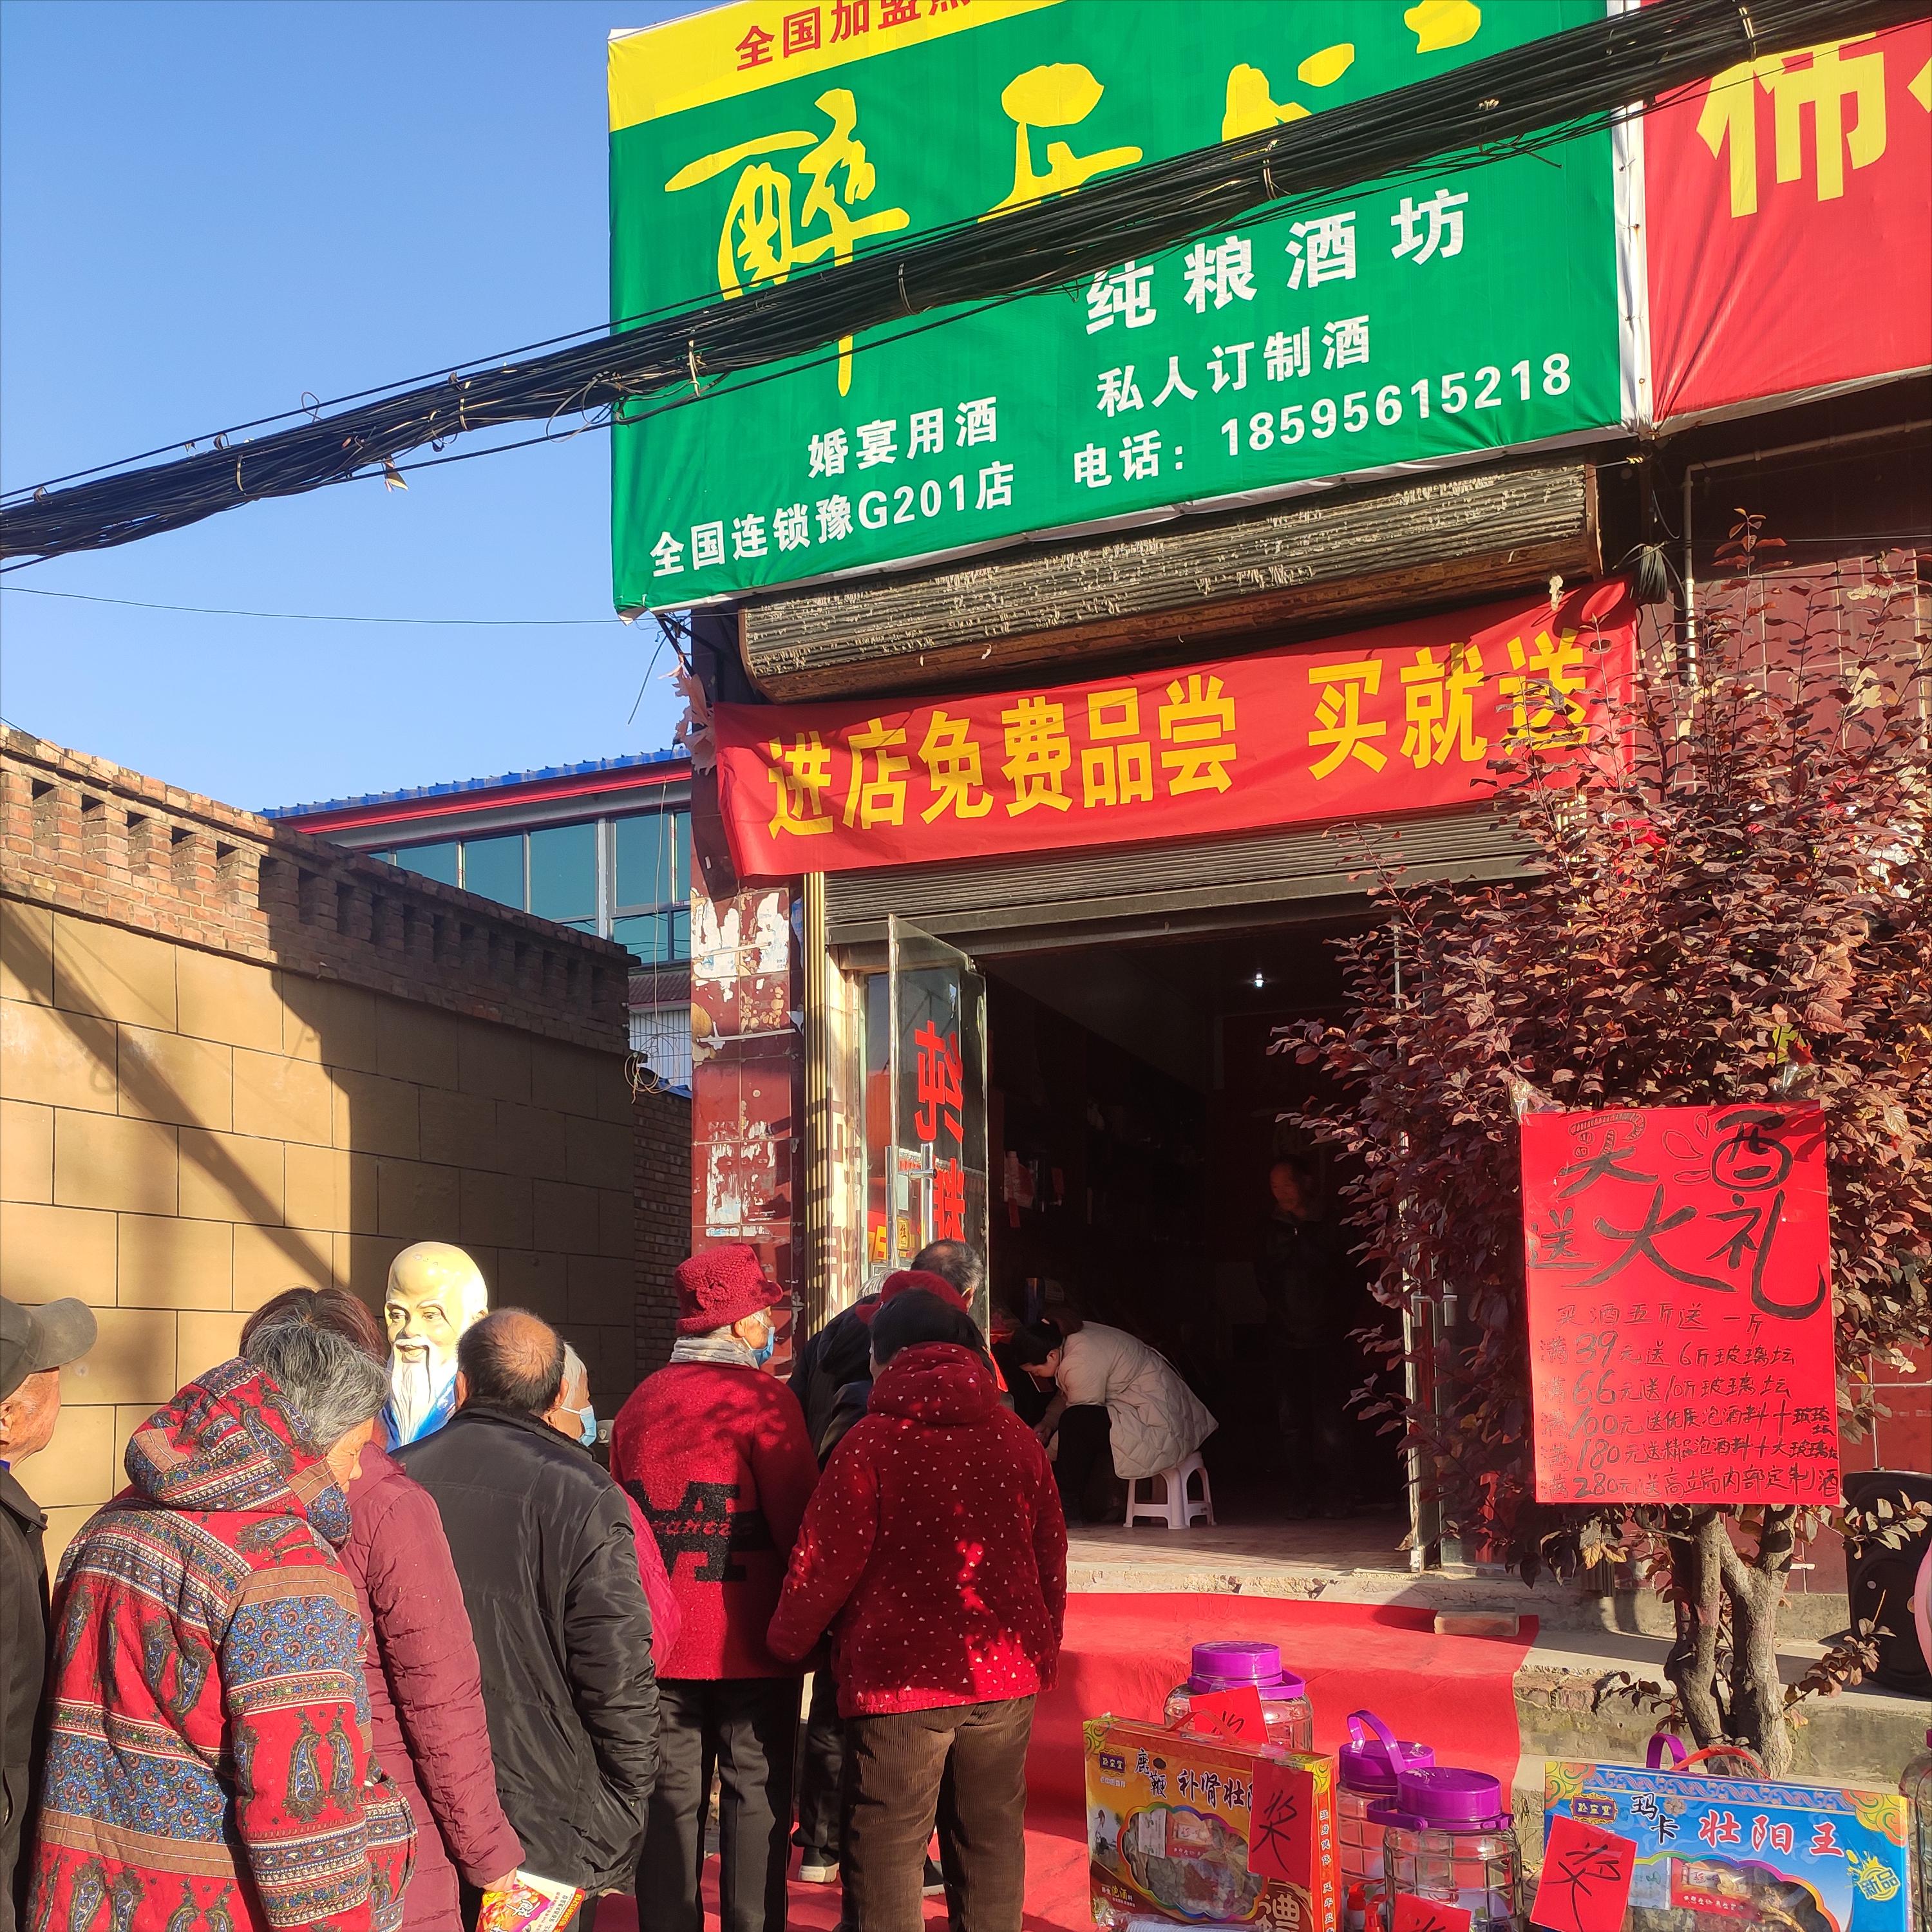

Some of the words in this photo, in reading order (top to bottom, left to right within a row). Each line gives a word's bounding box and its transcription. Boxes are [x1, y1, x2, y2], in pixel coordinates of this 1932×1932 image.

[735, 0, 969, 71] 全国加盟
[1086, 188, 1469, 335] 纯粮酒坊
[1096, 314, 1370, 418] 私人订制酒
[1222, 352, 1571, 456] 18595615218
[808, 396, 998, 479] 婚宴用酒
[650, 460, 1015, 578] 全国连锁豫G201店
[768, 674, 1237, 840] 进店免费品尝
[1308, 627, 1591, 780] 买就送
[1177, 1770, 1253, 1813] 补肾壮
[1630, 1793, 1680, 1844] 玛卡
[1698, 1808, 1845, 1858] 壮阳王
